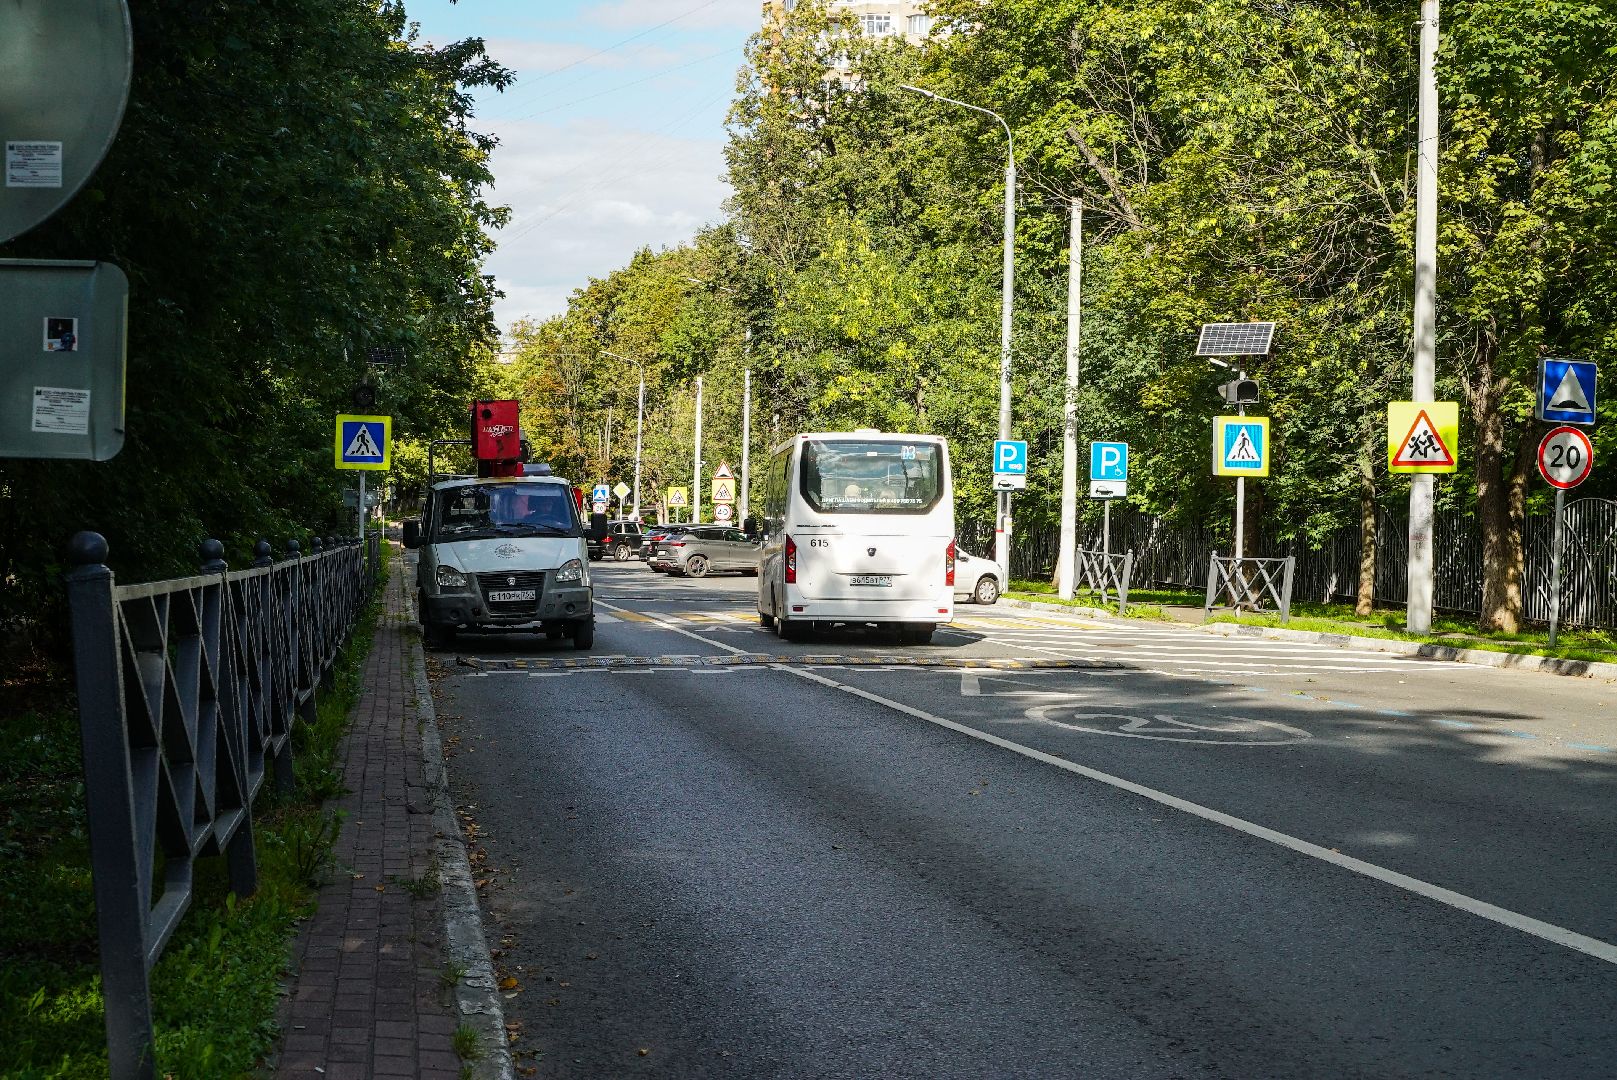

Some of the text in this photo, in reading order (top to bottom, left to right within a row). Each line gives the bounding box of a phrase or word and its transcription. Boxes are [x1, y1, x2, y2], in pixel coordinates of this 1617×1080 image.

[1000, 445, 1018, 469] P
[1101, 447, 1120, 476] P
[1550, 445, 1581, 469] 20
[810, 539, 829, 547] 615
